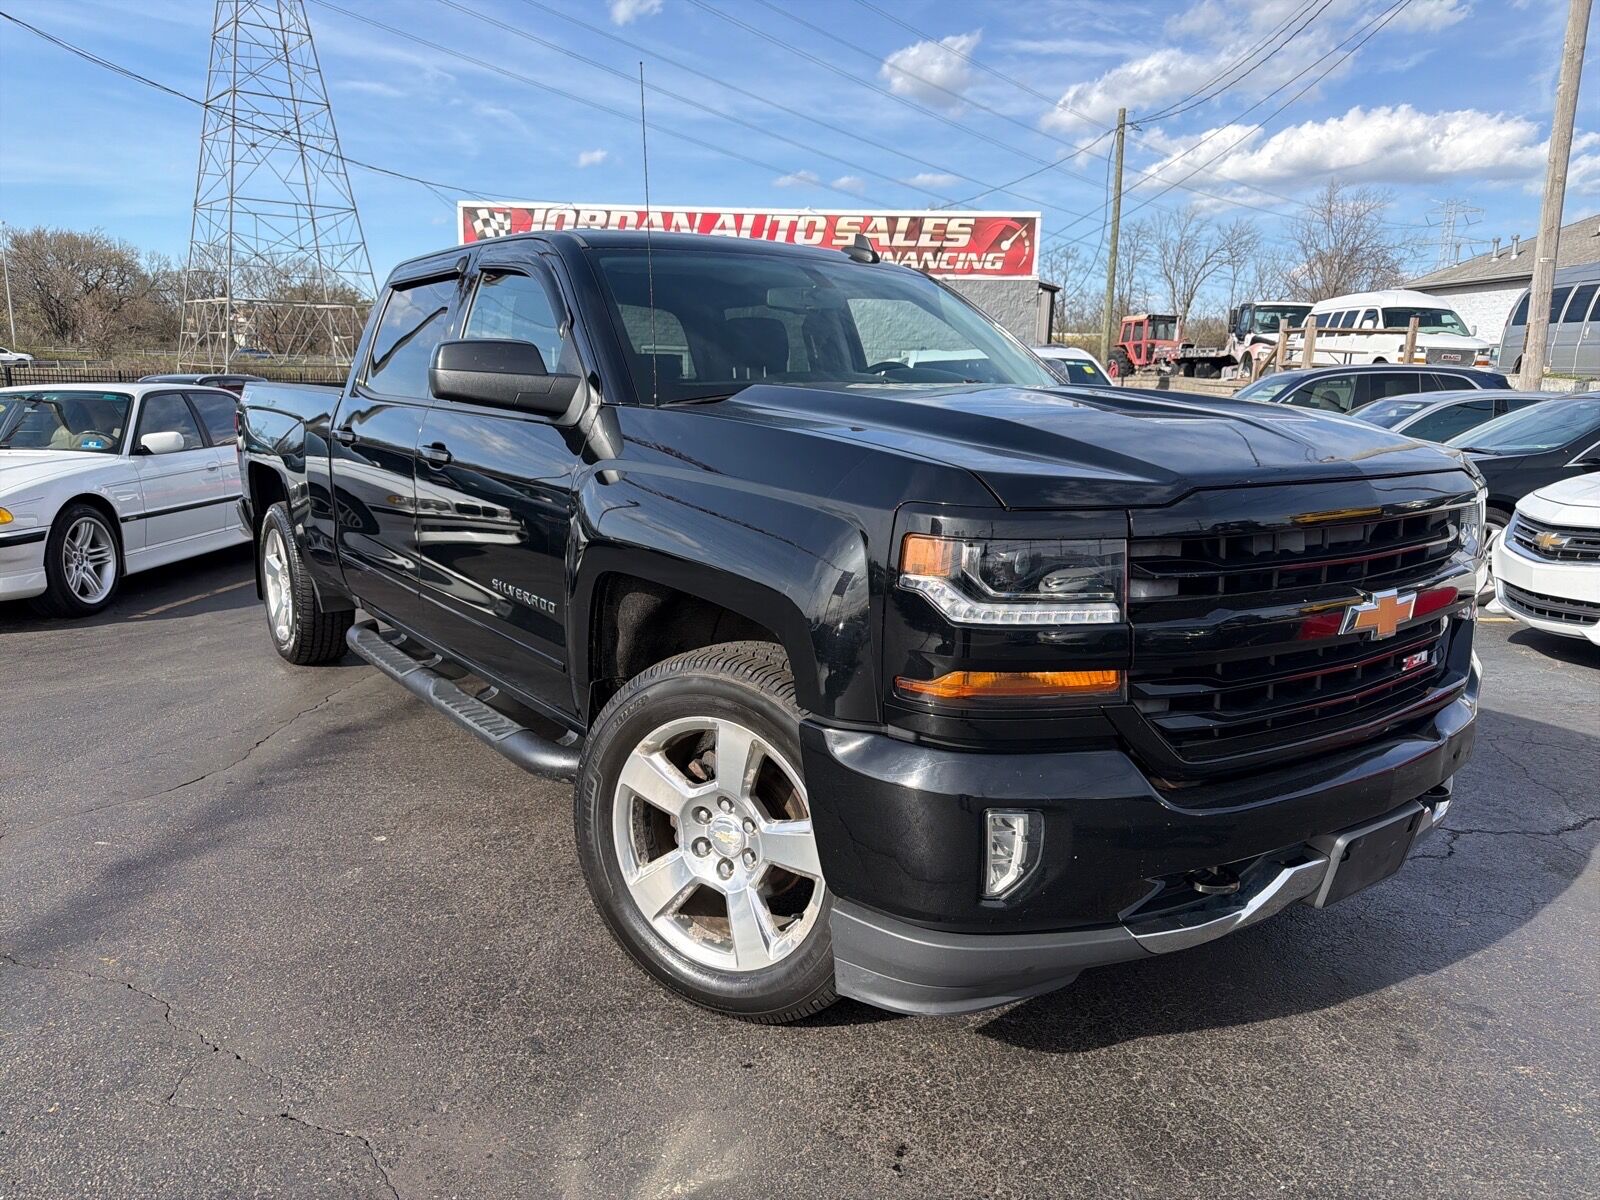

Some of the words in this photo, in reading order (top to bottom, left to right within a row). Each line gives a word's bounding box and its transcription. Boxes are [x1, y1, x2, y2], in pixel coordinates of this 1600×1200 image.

[518, 208, 703, 234] JORDAN
[708, 212, 828, 246] AUTO
[832, 215, 976, 248] SALES
[491, 578, 557, 615] SILVERADO
[1402, 649, 1428, 671] Z71
